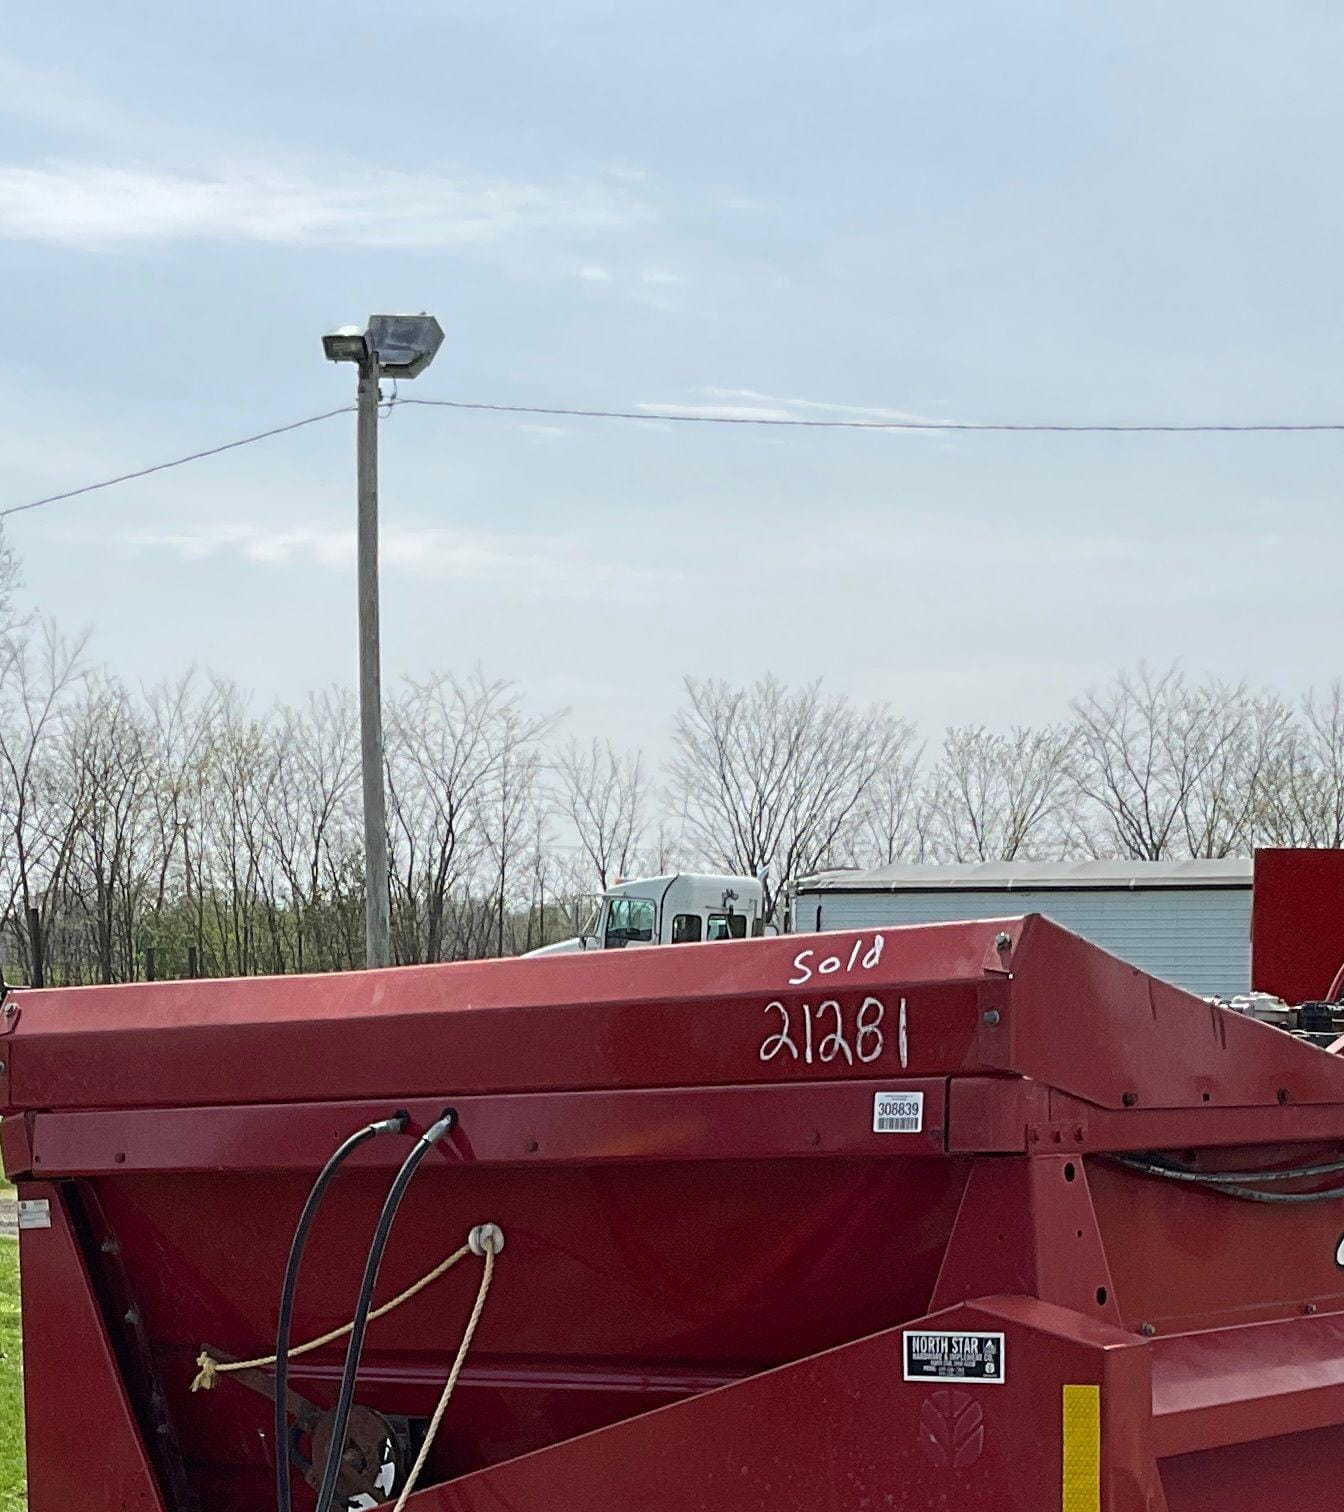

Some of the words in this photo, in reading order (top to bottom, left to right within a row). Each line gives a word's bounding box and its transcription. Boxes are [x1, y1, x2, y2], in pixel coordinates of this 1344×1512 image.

[788, 934, 885, 985] Sold
[760, 996, 908, 1068] 21281
[878, 1102, 919, 1116] 308839
[912, 1336, 948, 1353] NORTH
[951, 1337, 979, 1354] STAR
